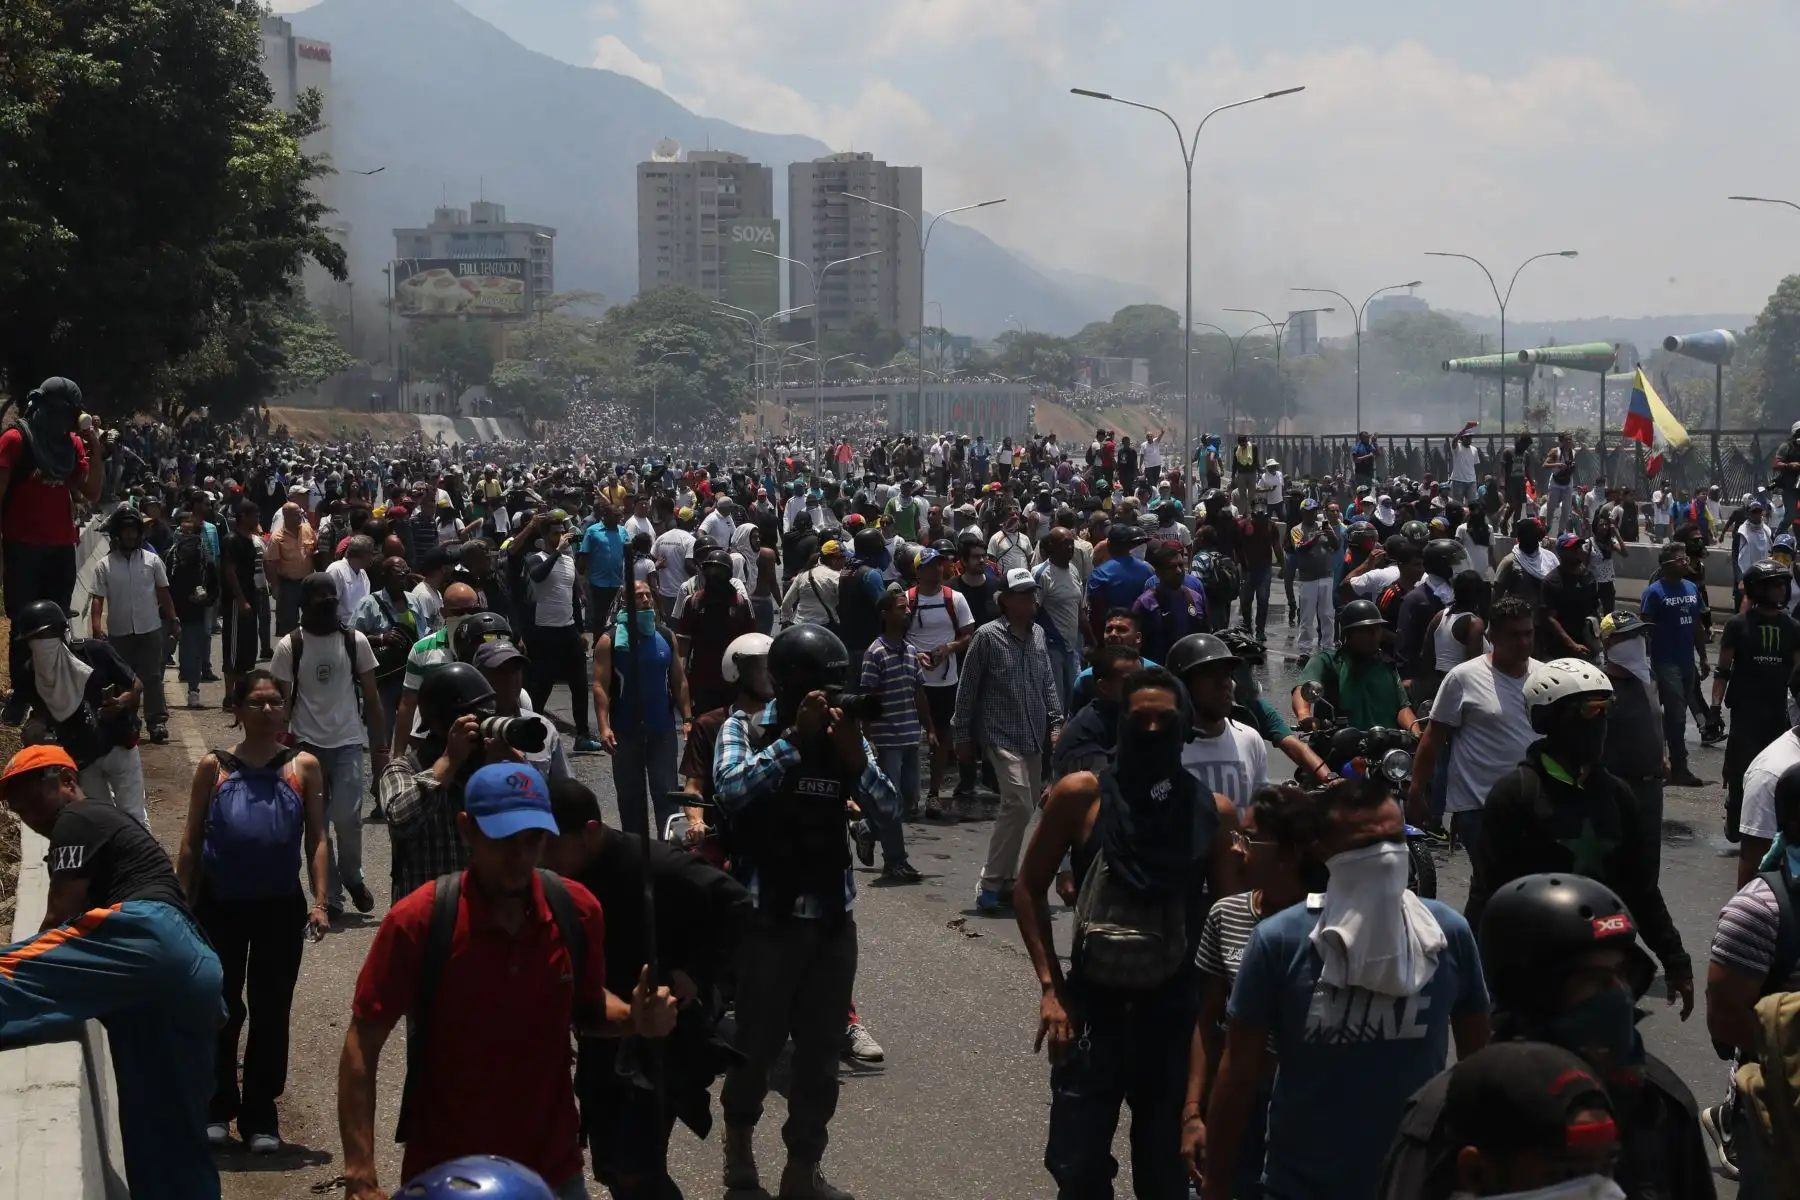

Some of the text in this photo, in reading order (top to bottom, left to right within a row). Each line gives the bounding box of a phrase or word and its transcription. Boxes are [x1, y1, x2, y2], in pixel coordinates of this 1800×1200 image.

[731, 225, 775, 242] SOYA
[459, 262, 479, 275] FULL
[797, 780, 835, 794] ENSA
[1599, 918, 1625, 931] XG
[1303, 980, 1431, 1043] NIKE
